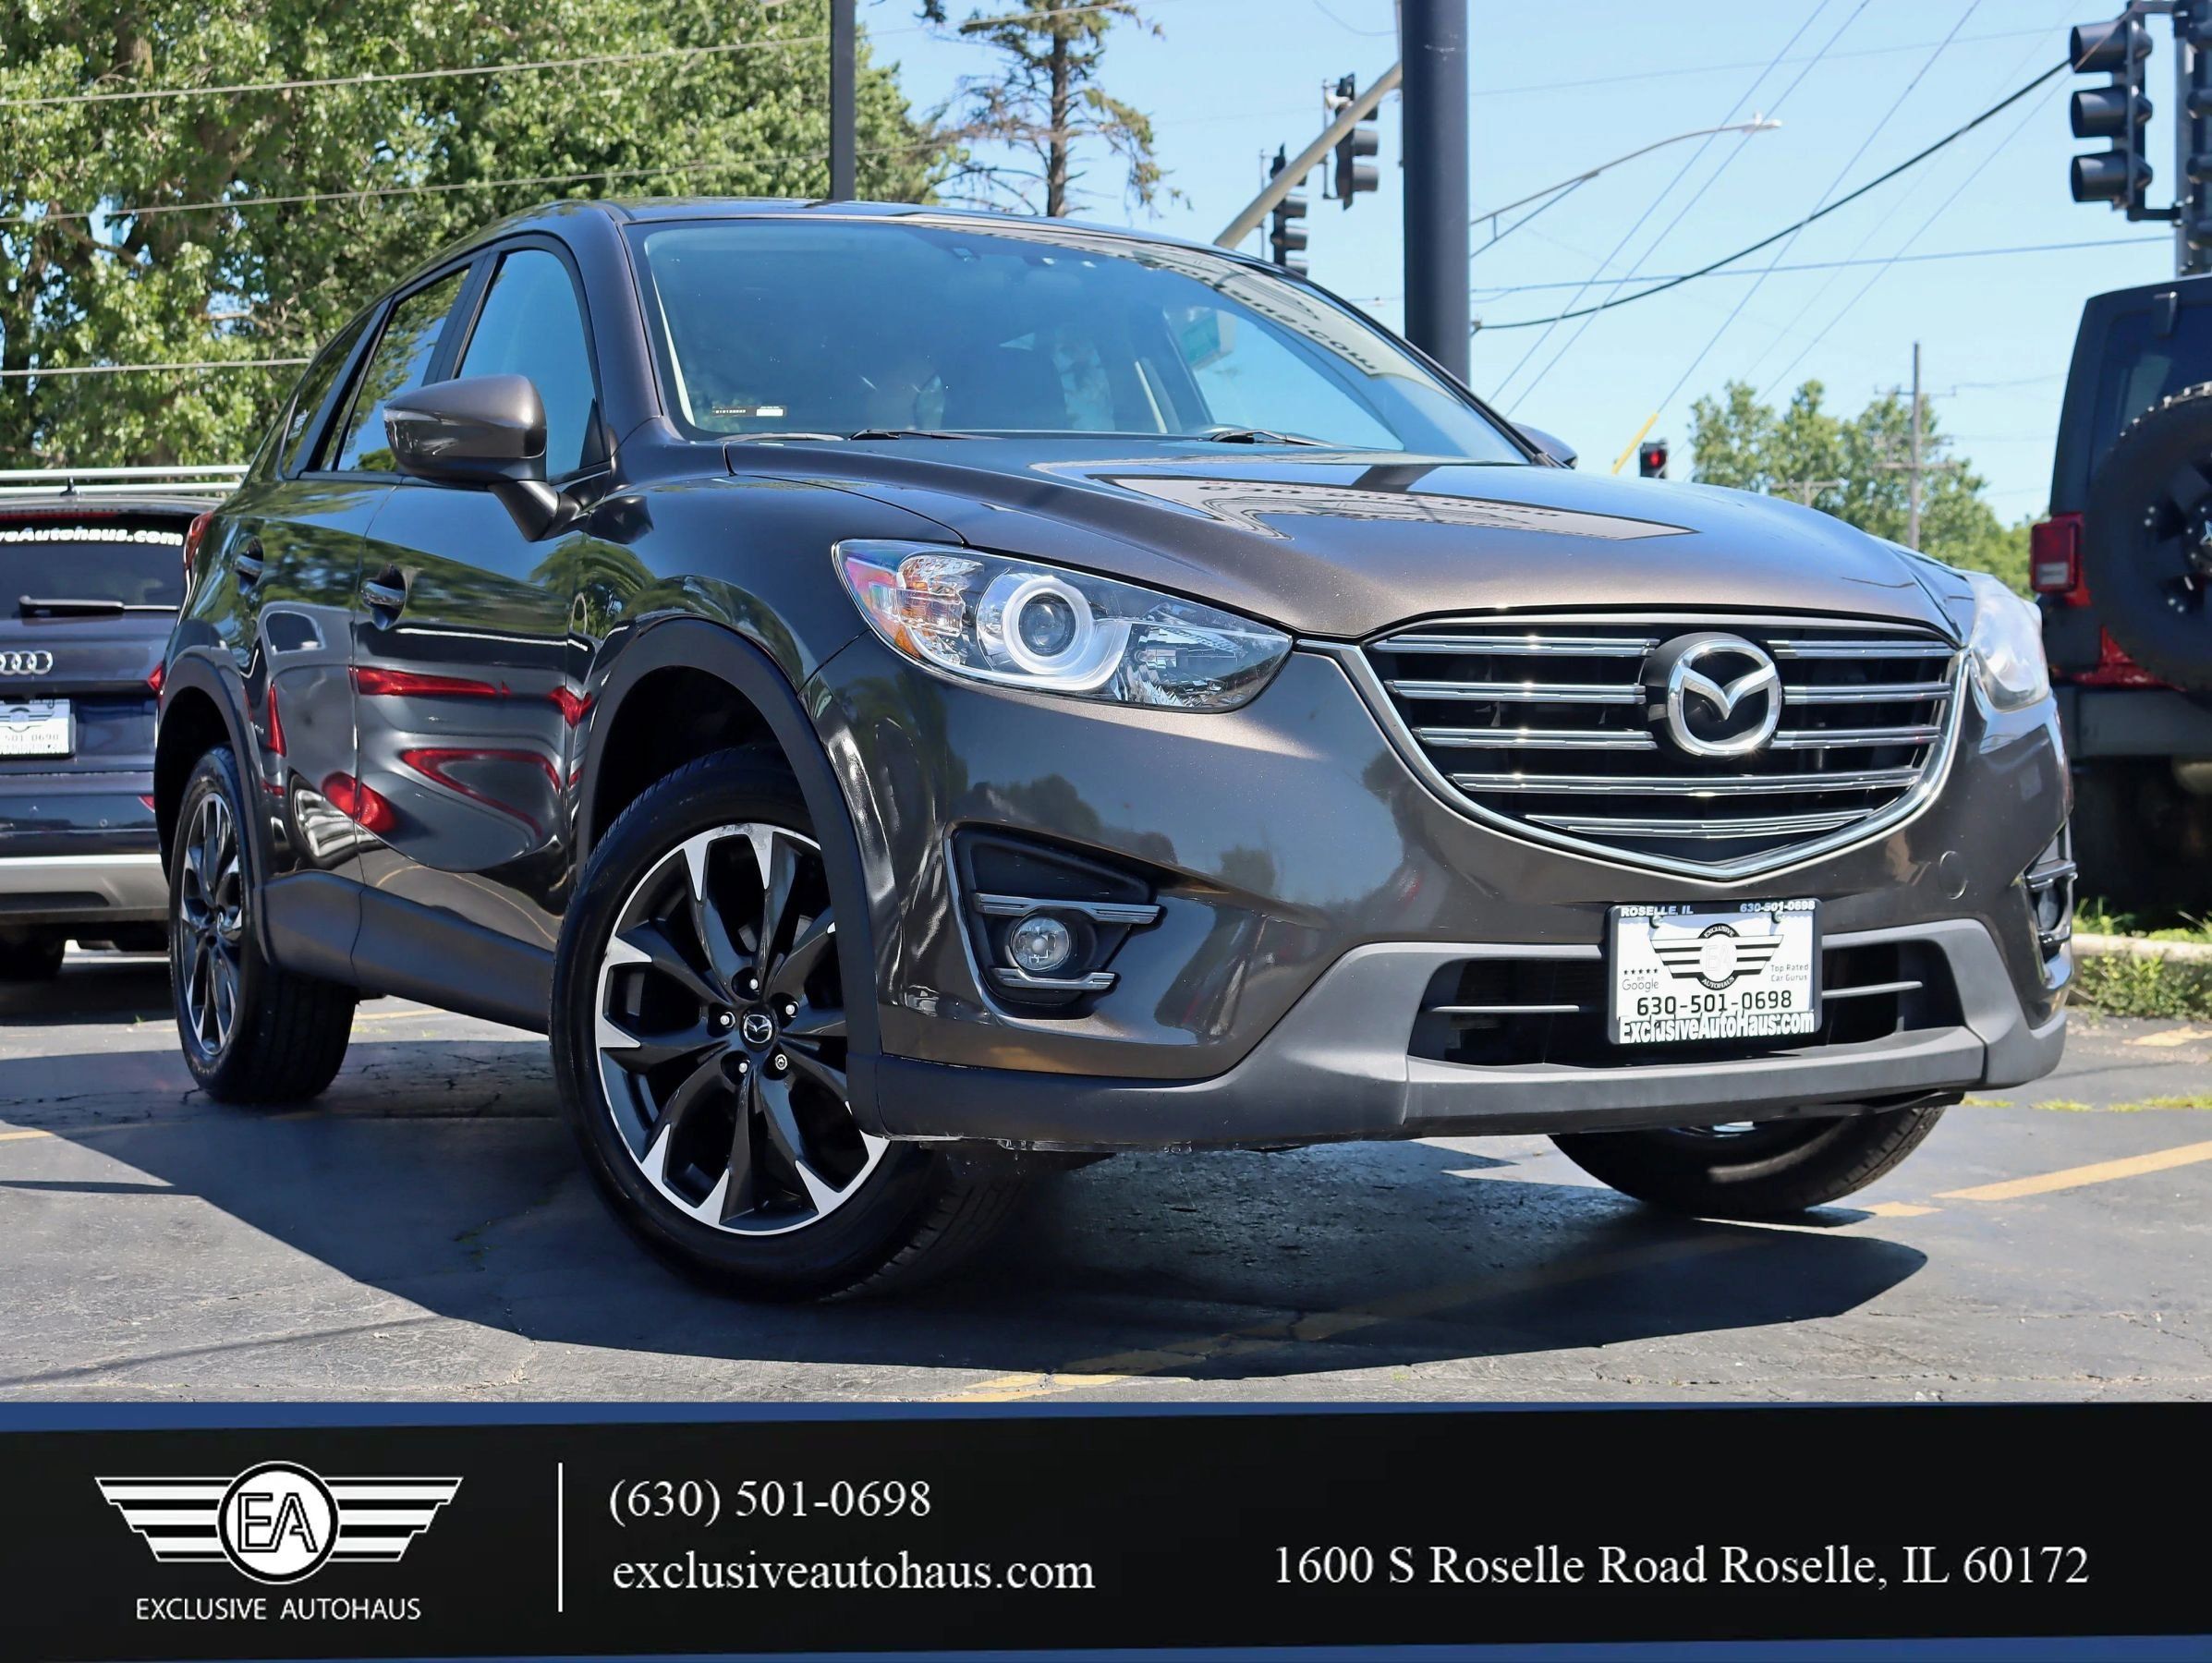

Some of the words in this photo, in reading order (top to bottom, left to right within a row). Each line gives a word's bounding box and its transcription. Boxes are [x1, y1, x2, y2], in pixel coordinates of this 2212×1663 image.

[1682, 904, 1694, 915] IL
[1740, 900, 1816, 913] 630-501-0698
[1704, 926, 1735, 939] EXCLUSIVE
[1770, 965, 1784, 973] Top
[1622, 977, 1659, 992] Google
[1701, 976, 1735, 989] AUTOHAUS
[1785, 974, 1807, 982] Gurus
[1636, 989, 1793, 1016] 630-501-0698
[1619, 1010, 1815, 1044] ExclusiveAutoHaus.com
